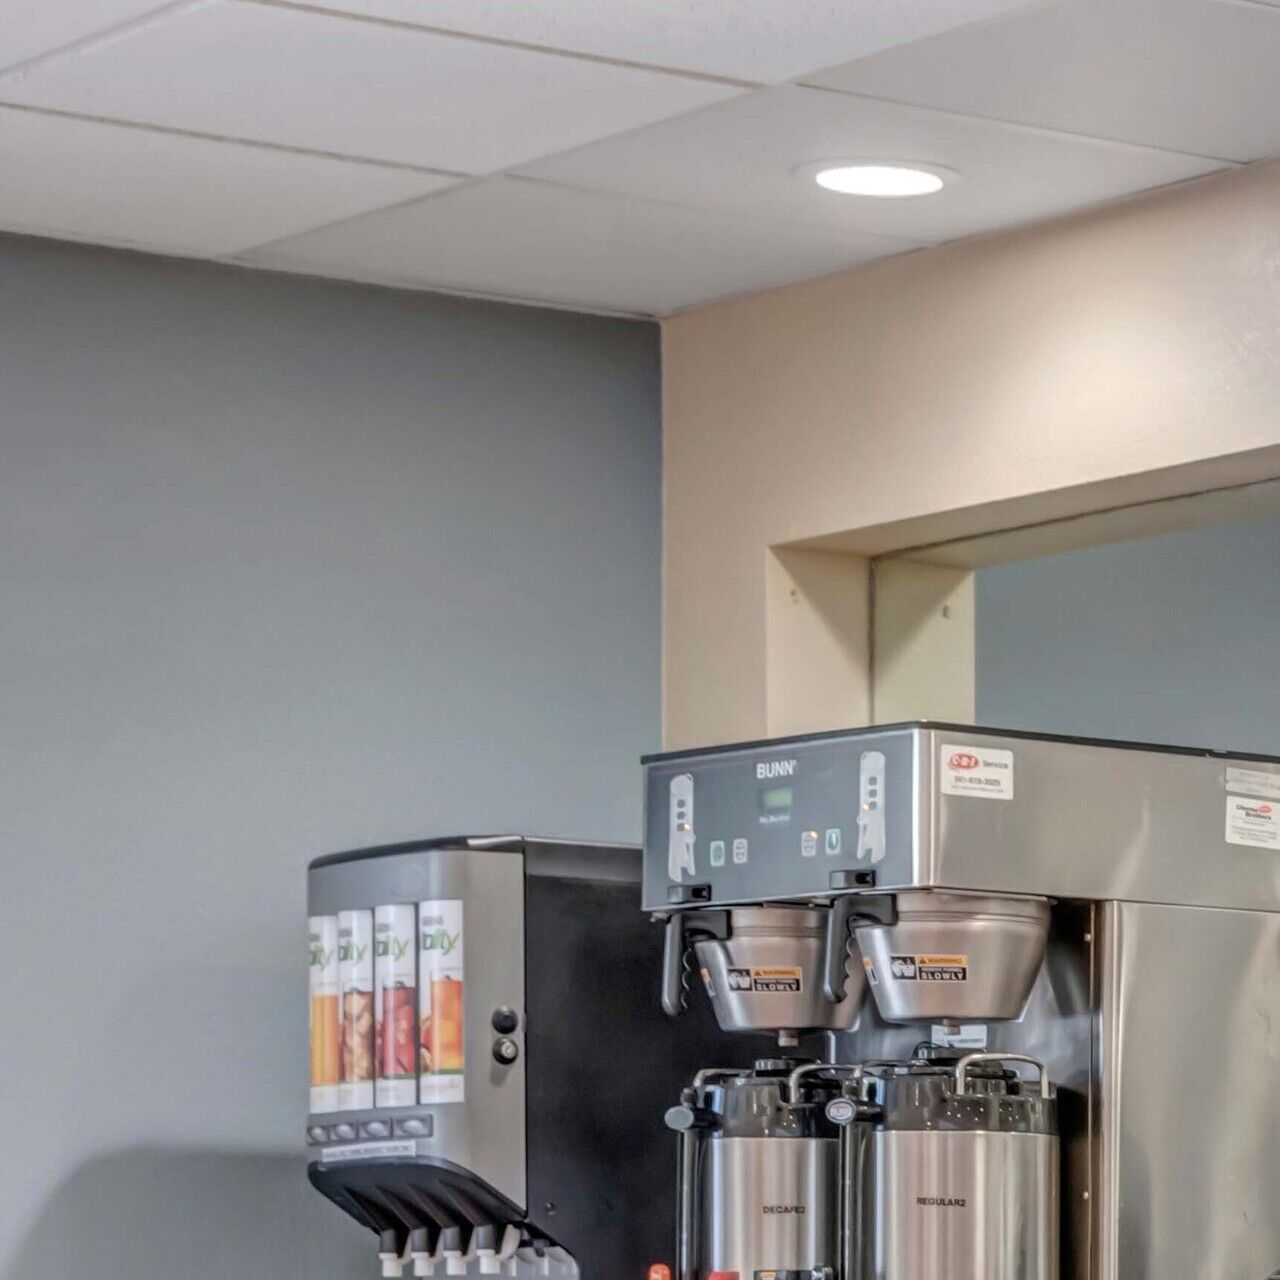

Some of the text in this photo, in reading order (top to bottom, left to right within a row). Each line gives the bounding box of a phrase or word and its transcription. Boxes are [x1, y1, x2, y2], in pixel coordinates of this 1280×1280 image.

[756, 760, 794, 779] BUNN
[920, 971, 964, 981] SLOWLY
[756, 982, 798, 992] SLOWLY
